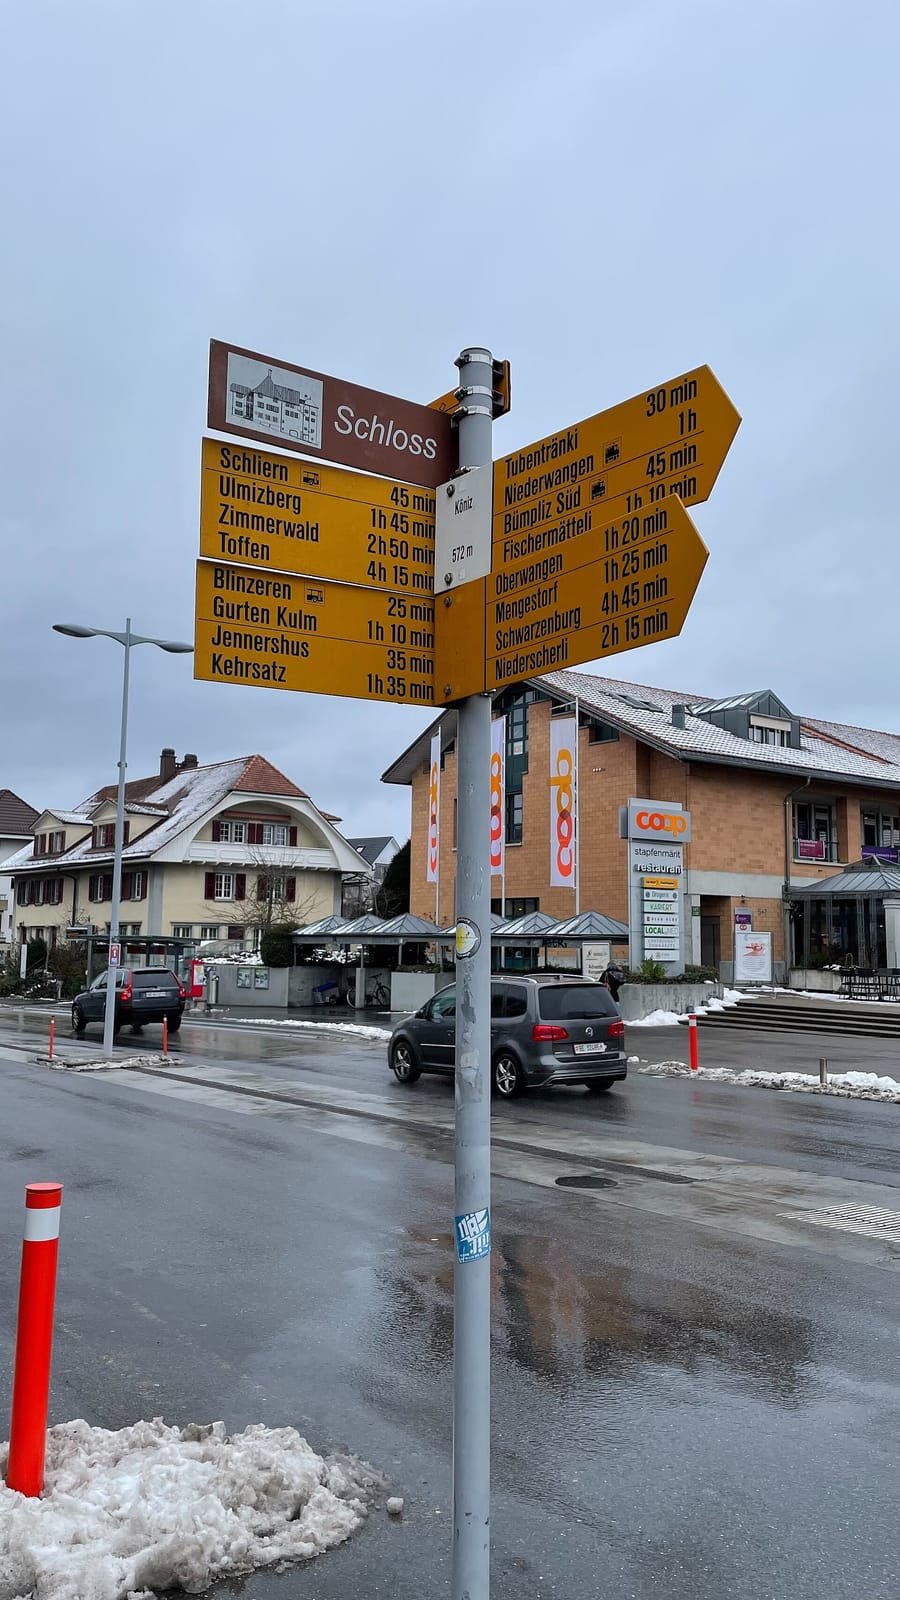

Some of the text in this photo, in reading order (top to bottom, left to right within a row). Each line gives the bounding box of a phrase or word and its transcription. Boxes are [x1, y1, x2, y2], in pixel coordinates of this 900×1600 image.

[334, 404, 438, 459] Schloss
[505, 378, 697, 479] Tubentränki 30 min
[219, 475, 302, 515] Ulmizberg
[390, 512, 409, 534] 45
[412, 520, 436, 539] min
[220, 448, 436, 514] Schliern 45 min
[454, 496, 473, 515] Köniz
[504, 455, 594, 507] Niederwangen
[504, 442, 697, 534] Bümpliz Süd 45 min
[218, 503, 319, 543] Zimmerwald
[389, 538, 409, 560] 50
[412, 545, 436, 565] min
[218, 532, 270, 561] Toffen
[393, 565, 408, 586] 15
[412, 571, 435, 590] min
[452, 545, 473, 563] 572 m
[496, 553, 563, 595] Oberwangen
[622, 516, 640, 545] 20
[643, 508, 667, 537] min
[504, 510, 592, 563] Fischermätteli
[214, 568, 434, 622] Blinzeren 25 min
[496, 580, 558, 624] Mengestorf
[622, 548, 640, 578] 25
[643, 541, 668, 570] min
[214, 596, 270, 625] Gurten
[277, 606, 317, 632] Kulm
[391, 624, 406, 644] 10
[410, 628, 434, 648] min
[496, 607, 581, 651] Schwarzenburg
[622, 581, 640, 608] 45
[644, 574, 668, 603] min
[211, 625, 434, 674] Jennershus 35 min
[495, 638, 568, 680] Niederscherli
[624, 614, 640, 642] 15
[644, 608, 668, 637] min
[212, 652, 287, 682] Kehrsatz
[386, 676, 406, 697] 35
[410, 680, 434, 700] min
[550, 748, 572, 878] coop
[636, 811, 687, 838] coop
